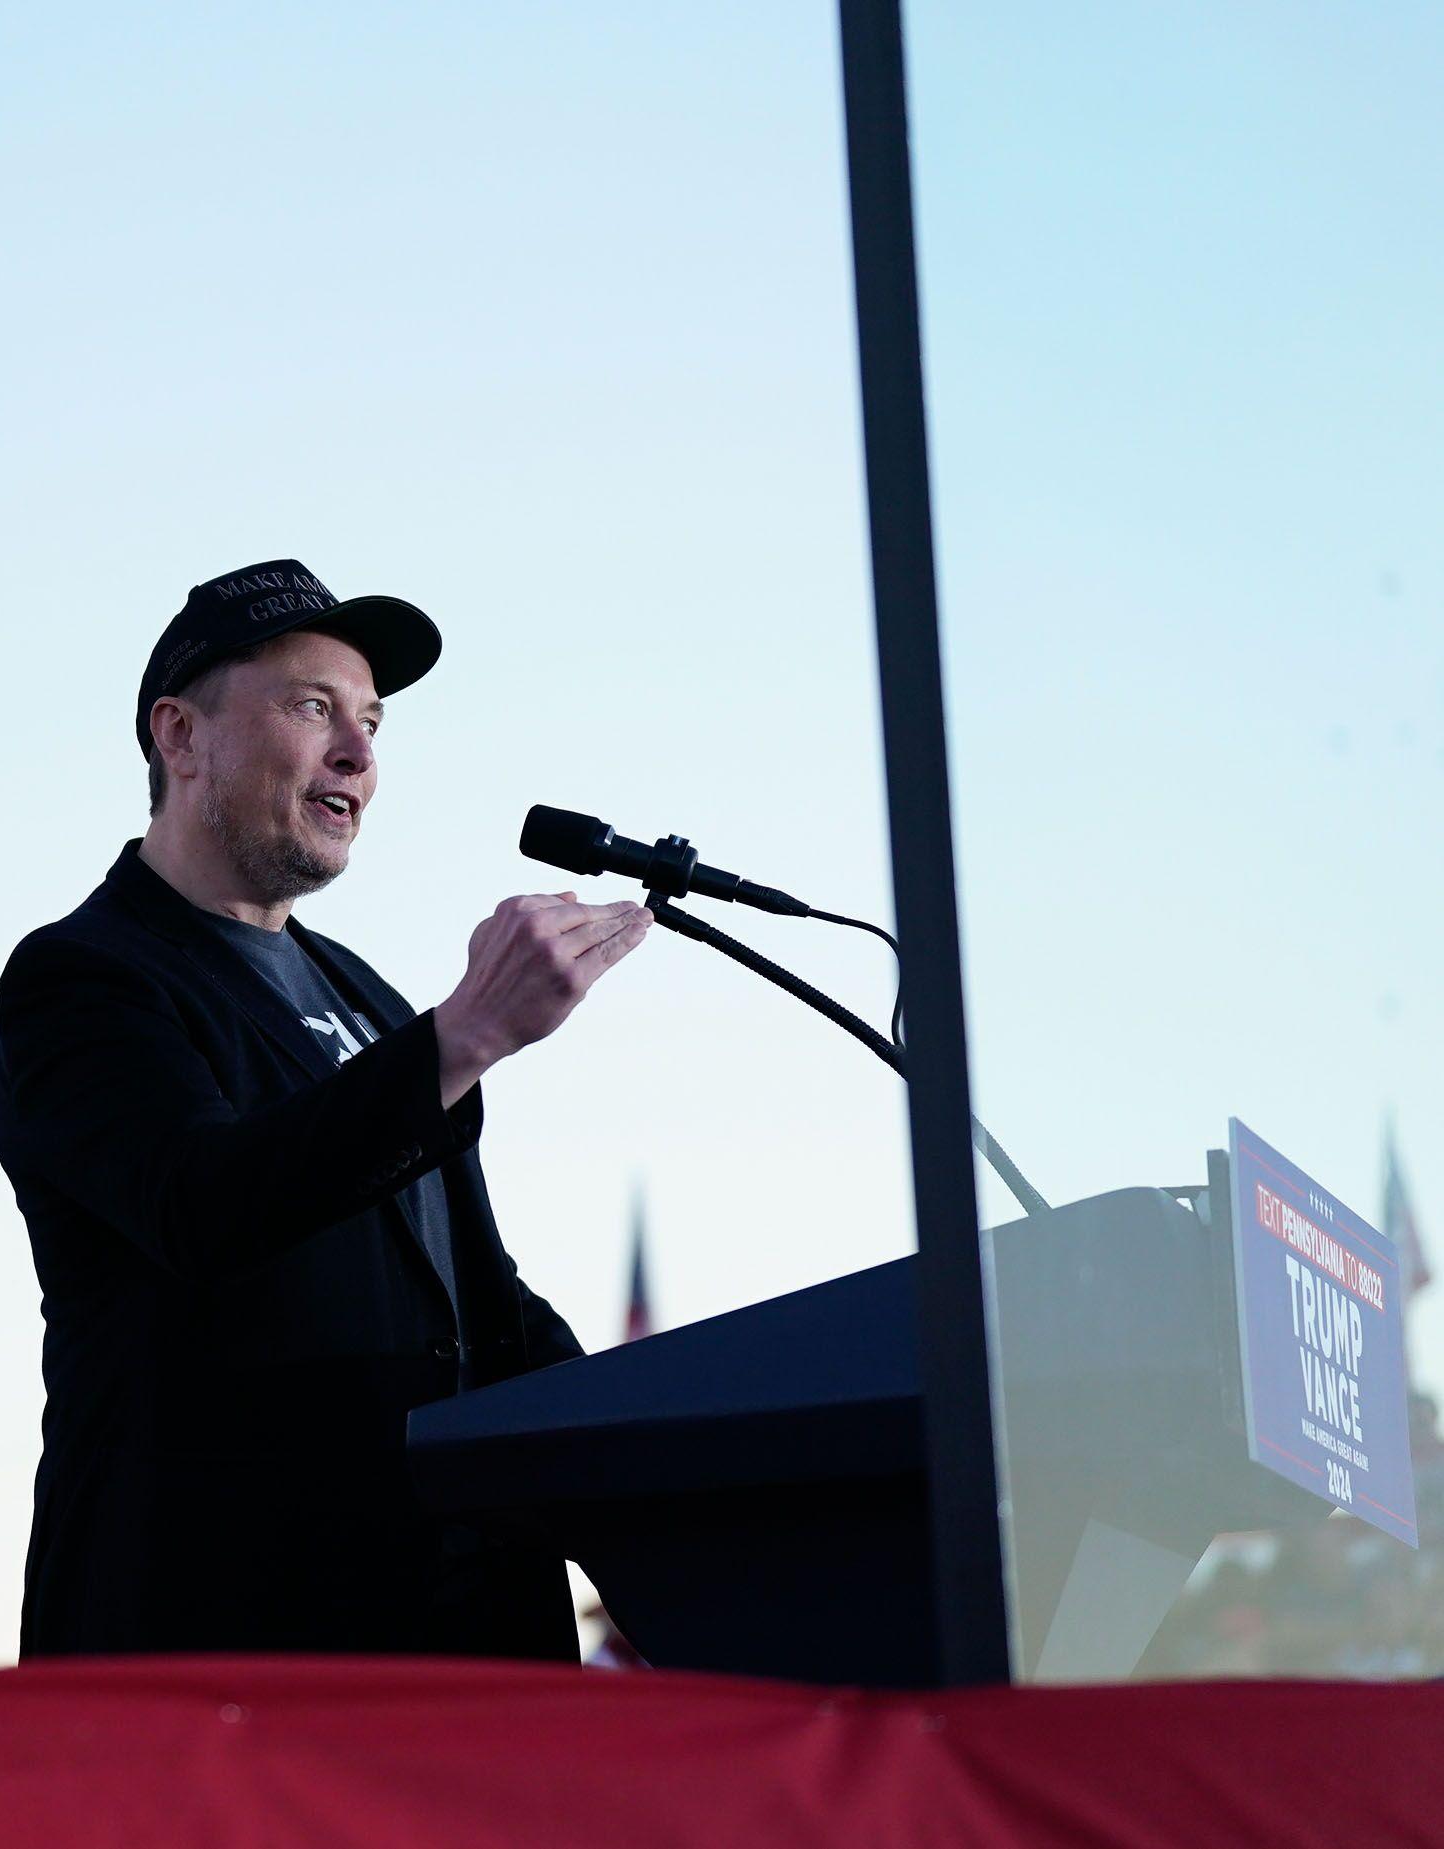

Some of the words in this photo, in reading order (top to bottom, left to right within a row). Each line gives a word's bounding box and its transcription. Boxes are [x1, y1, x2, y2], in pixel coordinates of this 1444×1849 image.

[214, 571, 291, 600] MAKE
[250, 593, 325, 621] GREAT
[1257, 1183, 1280, 1234] TEXT
[1282, 1202, 1346, 1283] PENNSYLVANIA
[1345, 1251, 1358, 1291] TO
[1358, 1262, 1384, 1310] 88022
[1285, 1254, 1363, 1377] TRUMP
[1300, 1345, 1363, 1443] VANCE
[1301, 1417, 1316, 1442] MAKE
[1316, 1425, 1338, 1455] AMERICA
[1337, 1439, 1353, 1463] GREAT
[1326, 1458, 1353, 1505] 2024
